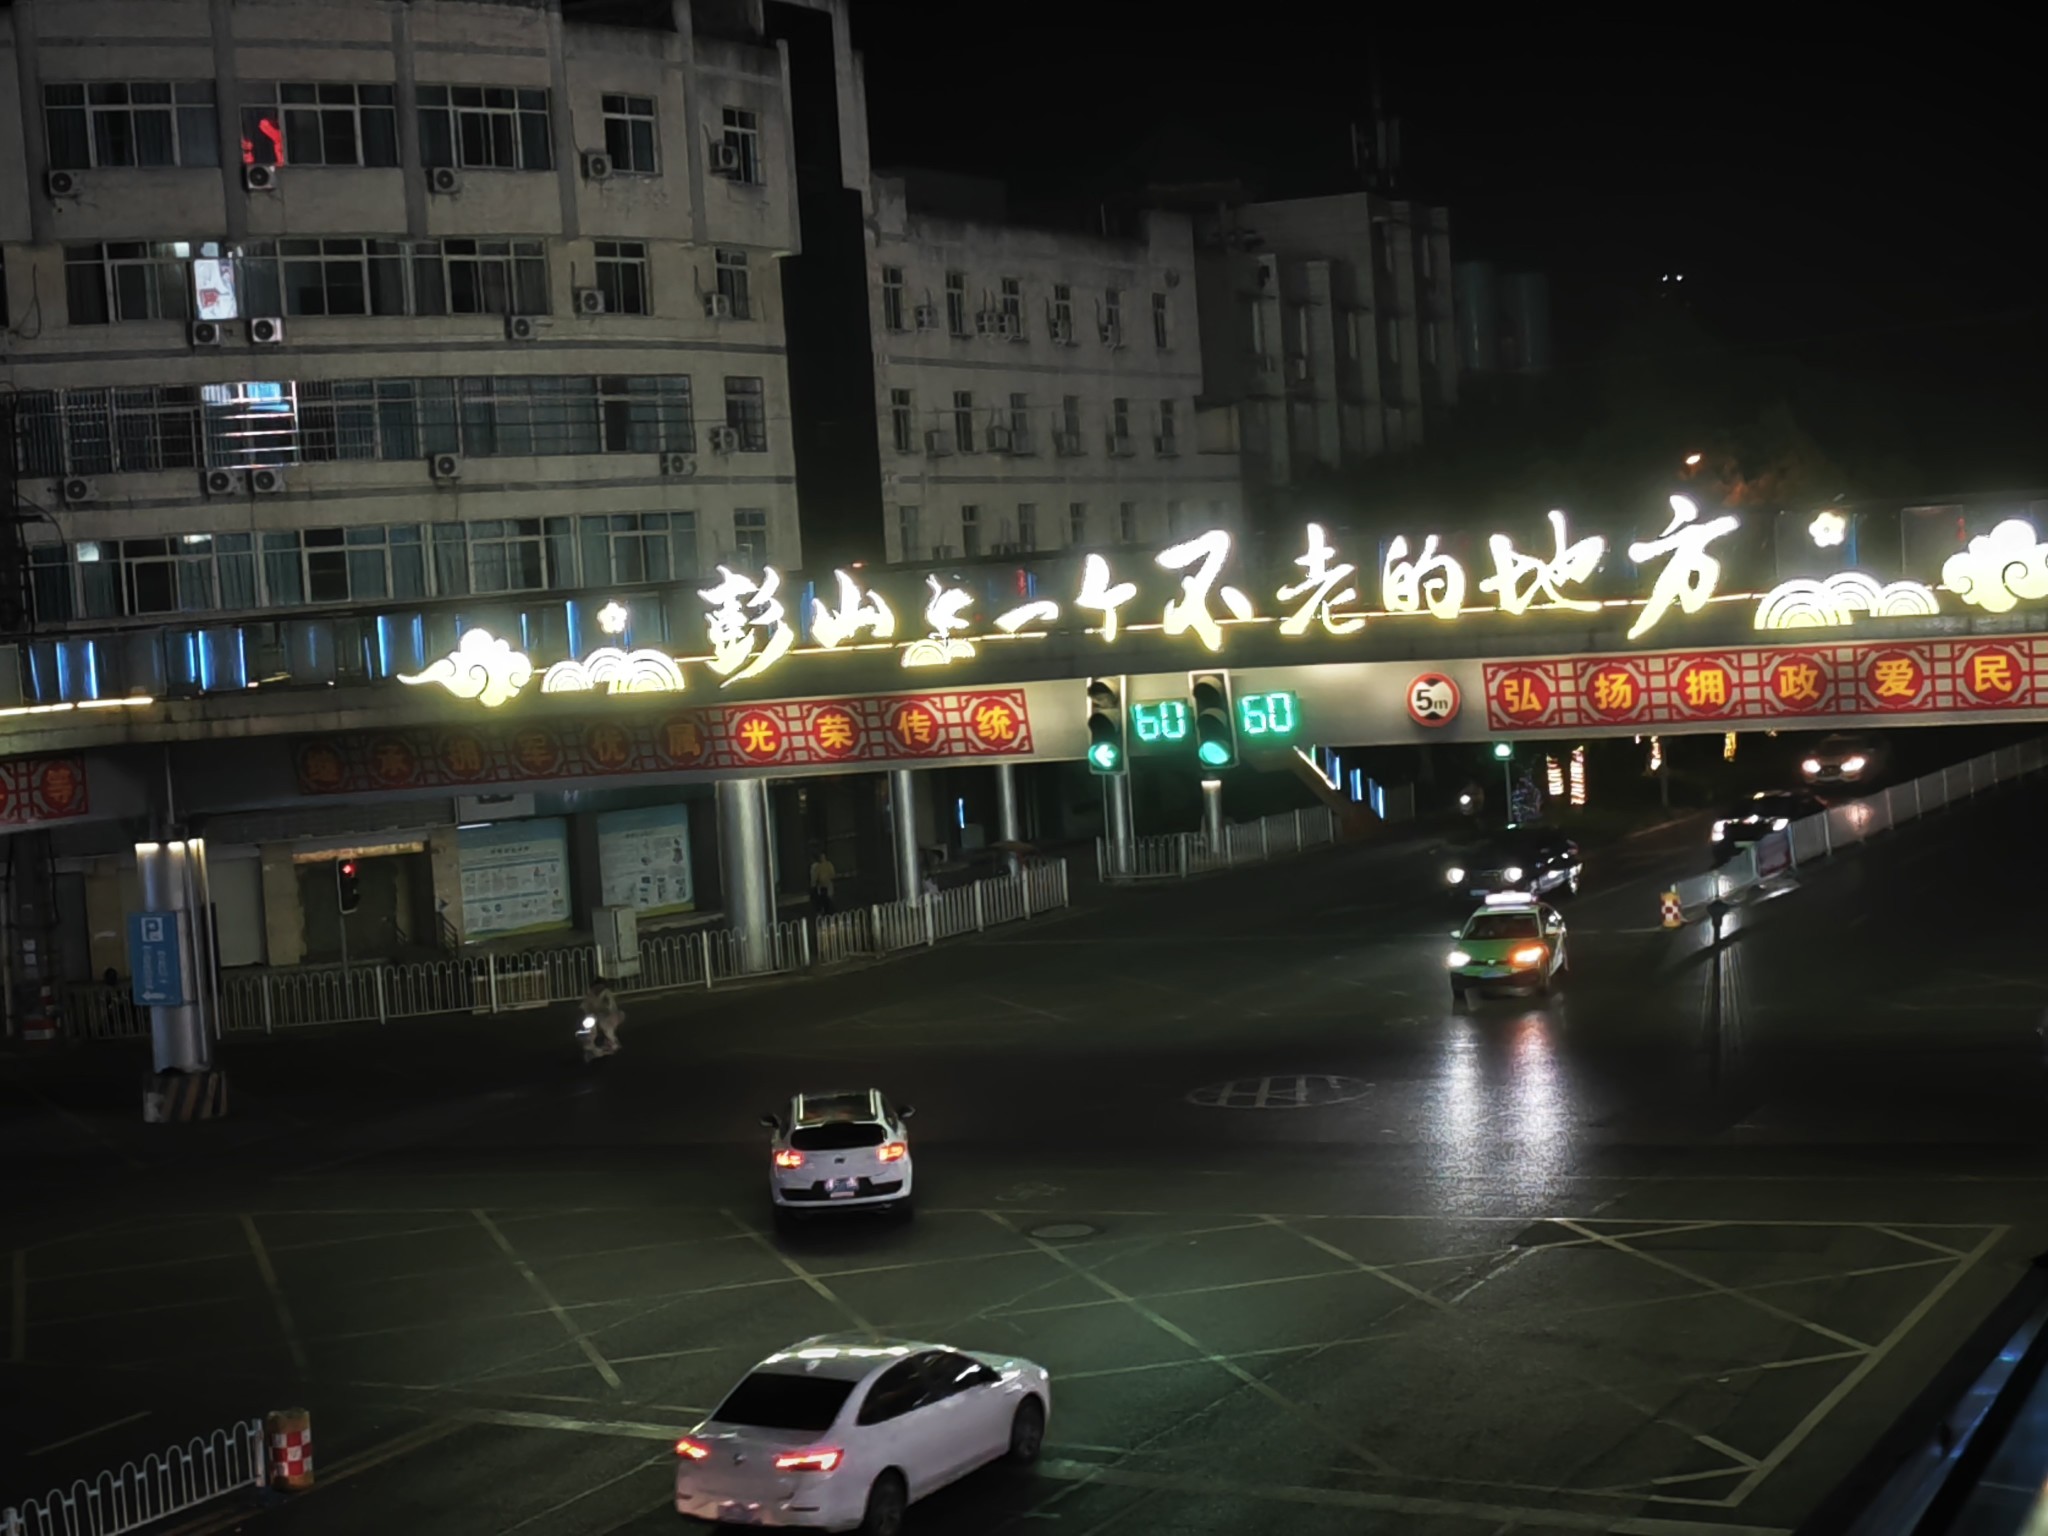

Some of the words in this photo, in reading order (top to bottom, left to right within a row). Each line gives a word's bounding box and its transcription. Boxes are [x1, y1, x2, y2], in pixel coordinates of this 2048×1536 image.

[1415, 688, 1449, 711] 5m
[1503, 655, 2014, 714] 弘扬拥政爱民
[1135, 700, 1186, 741] 60
[1241, 693, 1293, 734] 60
